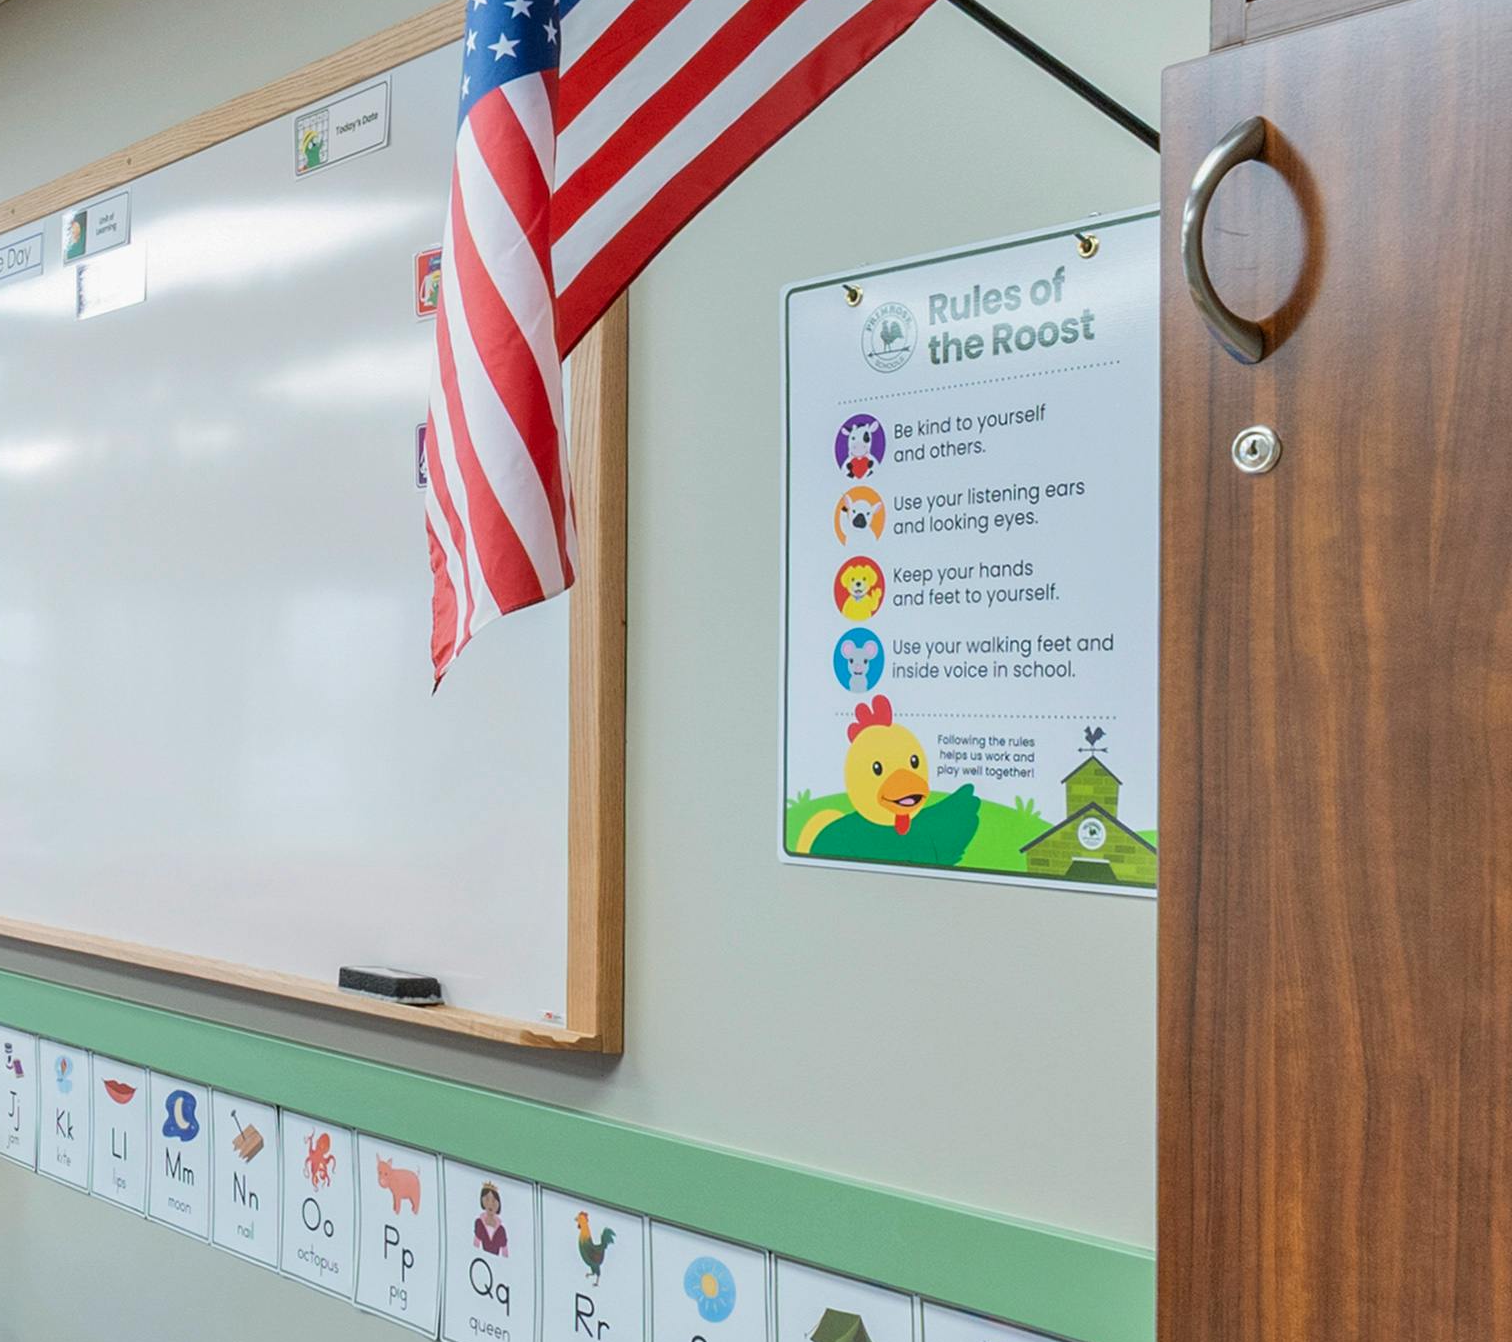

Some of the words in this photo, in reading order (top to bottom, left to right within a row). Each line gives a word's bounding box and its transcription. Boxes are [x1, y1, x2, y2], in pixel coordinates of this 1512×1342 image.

[363, 112, 379, 124] Date
[7, 246, 31, 269] Day
[929, 284, 1021, 325] Rules
[1029, 265, 1065, 306] of
[928, 332, 984, 365] the
[992, 309, 1095, 356] Roost
[894, 424, 913, 439] Be
[918, 417, 951, 436] kind
[956, 416, 972, 431] to
[977, 403, 1046, 434] yourself
[894, 444, 925, 462] and
[930, 440, 986, 459] others.
[894, 496, 922, 511] Use
[927, 492, 963, 513] your
[968, 483, 1040, 506] listening
[1045, 481, 1085, 498] ears
[894, 517, 925, 535] and
[930, 513, 988, 534] looking
[994, 511, 1039, 531] eyes.
[893, 567, 933, 586] Keep
[937, 566, 974, 585] your
[979, 559, 1034, 578] hands
[893, 590, 924, 607] and
[929, 588, 960, 605] feet
[965, 588, 982, 604] to
[986, 583, 1060, 608] yourself.
[893, 639, 921, 655] Use
[925, 640, 962, 658] your
[966, 636, 1032, 658] walking
[1037, 635, 1071, 652] feet
[1077, 634, 1114, 652] and
[892, 661, 939, 679] inside
[944, 661, 988, 678] voice
[993, 661, 1008, 678] in
[1013, 660, 1076, 678] school.
[937, 734, 986, 749] Following
[989, 735, 1006, 747] the
[1008, 735, 1035, 747] rules
[939, 749, 968, 764] helps
[970, 752, 983, 761] us
[985, 750, 1010, 762] work
[1013, 752, 1035, 763] and
[937, 764, 960, 778] play
[962, 765, 983, 776] well
[985, 767, 1035, 780] together!
[8, 1090, 20, 1132] Jj
[55, 1107, 74, 1141] Kk
[165, 1147, 195, 1186] Mm
[233, 1171, 259, 1211] Nn
[167, 1195, 192, 1215] moon
[301, 1197, 335, 1238] Oo
[236, 1221, 254, 1240] nail
[297, 1244, 340, 1276] octopus
[384, 1224, 415, 1283] Pp
[389, 1285, 408, 1310] pig
[469, 1257, 510, 1317] Qq
[575, 1292, 610, 1341] Rr
